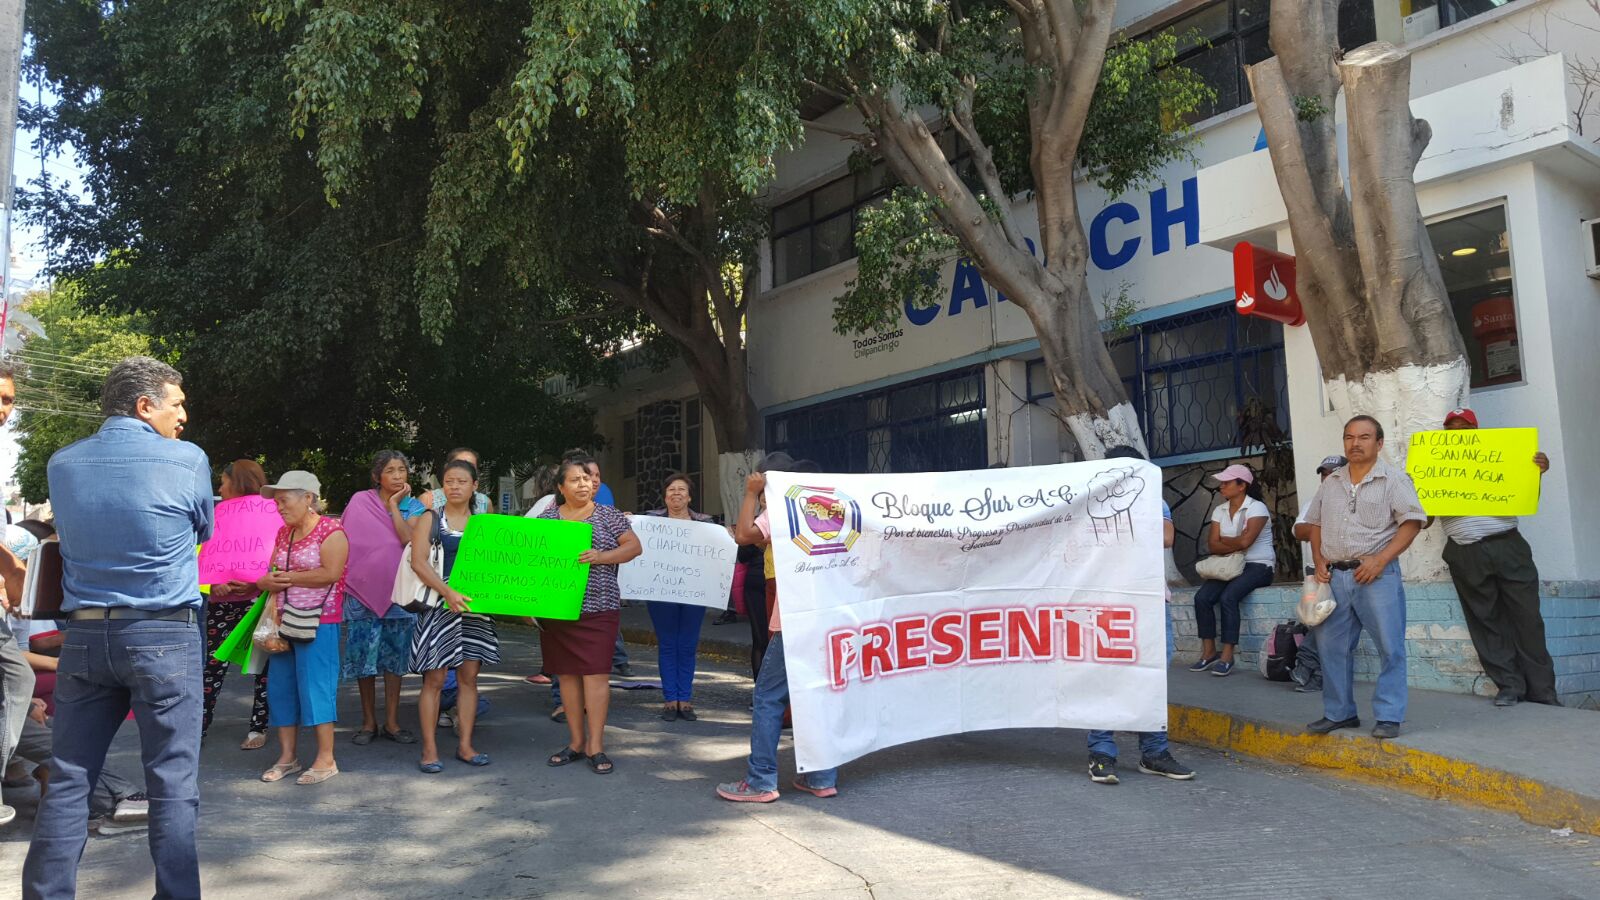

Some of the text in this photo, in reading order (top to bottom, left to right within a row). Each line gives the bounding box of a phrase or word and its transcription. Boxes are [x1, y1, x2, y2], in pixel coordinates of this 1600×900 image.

[904, 176, 1200, 327] CACH
[853, 329, 904, 350] Todos Somos
[854, 340, 900, 359] Chilpancingo
[1412, 432, 1480, 446] LA COLONIA
[1431, 448, 1504, 463] SAN ANGEL
[1413, 465, 1505, 484] SOLICITA AGUA
[1416, 487, 1478, 501] QUEREMOS
[871, 491, 954, 524] Bloque
[959, 487, 1014, 522] Sur
[640, 521, 692, 538] LOMAS DE
[883, 525, 904, 541] Por
[906, 527, 915, 538] el
[957, 525, 998, 541] Progreso
[1005, 515, 1054, 534] Prosperidad
[1054, 516, 1064, 524] de
[1064, 512, 1073, 522] la
[494, 527, 549, 550] COLONIA
[647, 536, 728, 560] CHAPULTEPEC
[959, 537, 1003, 553] Sociedad
[248, 560, 268, 571] SO
[463, 547, 581, 571] EMILIANO ZAPATA
[632, 560, 702, 578] TE PEDIMOS
[459, 570, 578, 590] NECESITAMOS AGUA
[652, 573, 686, 586] AGUA
[660, 587, 707, 599] DIRECTOR
[828, 605, 1136, 691] PRESENTE
